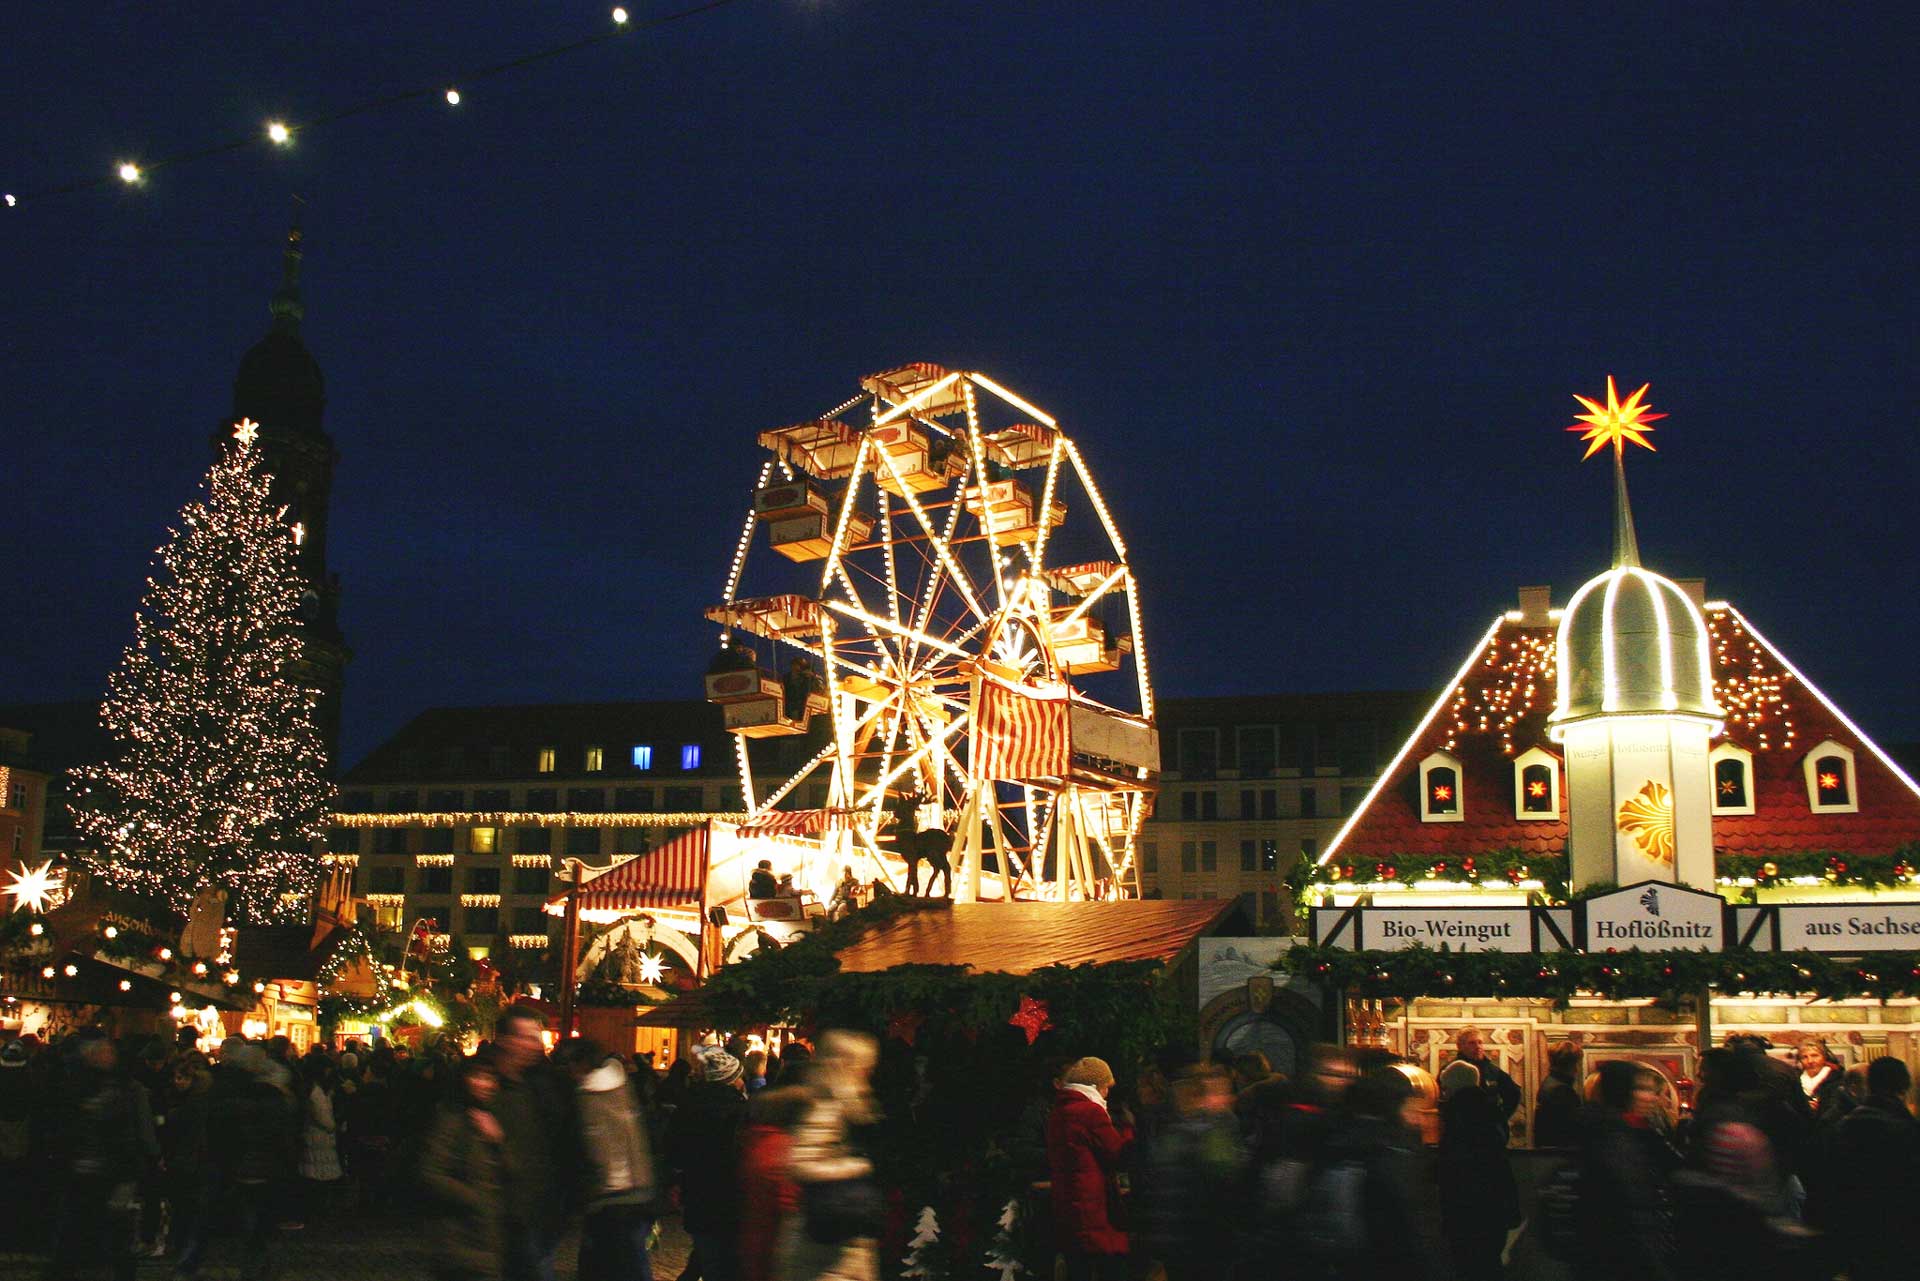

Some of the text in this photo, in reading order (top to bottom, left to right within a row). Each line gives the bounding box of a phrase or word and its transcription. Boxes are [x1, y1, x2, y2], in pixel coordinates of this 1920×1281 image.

[1382, 919, 1512, 940] Bio-Weingut
[1596, 919, 1713, 939] Hoflößnitz
[1806, 922, 1842, 935] aus
